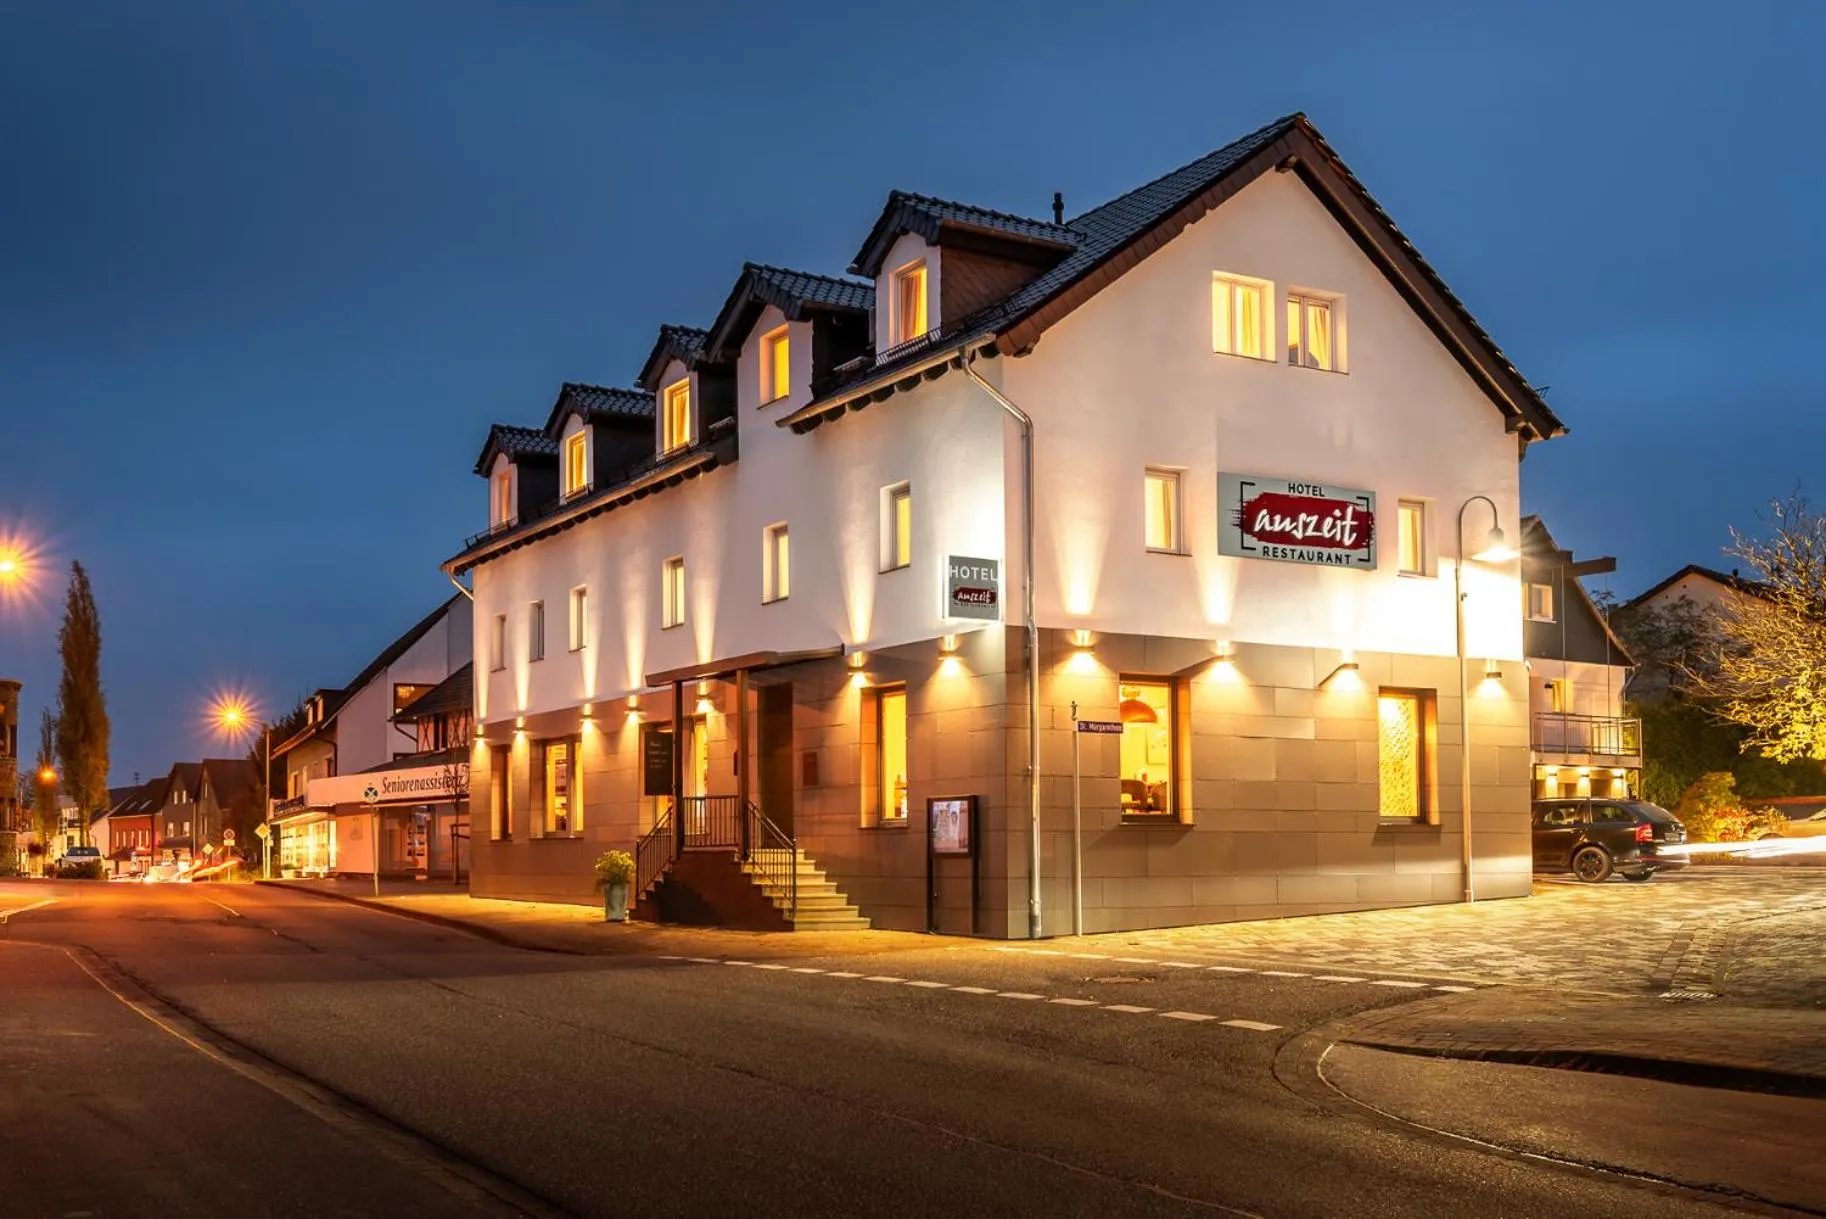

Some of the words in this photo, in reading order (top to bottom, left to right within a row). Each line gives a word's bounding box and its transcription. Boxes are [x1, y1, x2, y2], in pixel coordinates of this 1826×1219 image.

[1288, 483, 1325, 497] HOTEL
[1253, 504, 1359, 546] auszeit
[1262, 546, 1352, 565] RESTAURANT
[949, 565, 998, 581] HOTEL
